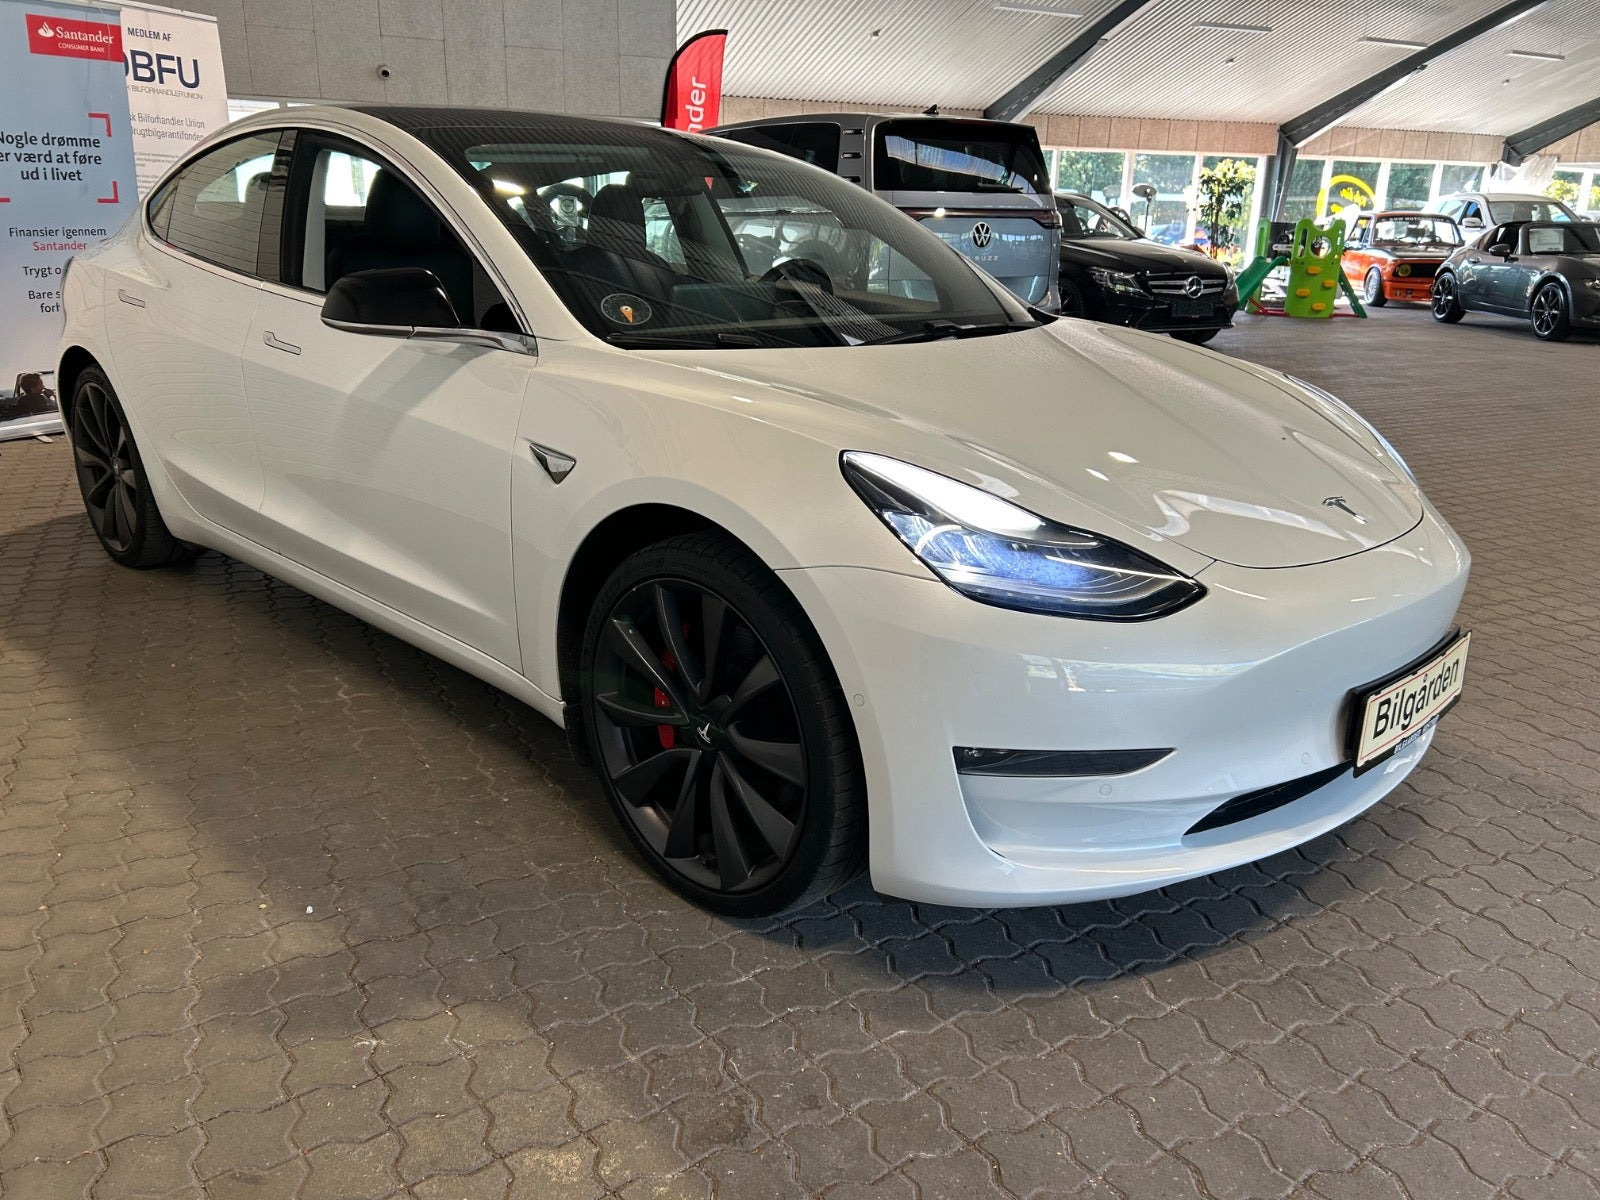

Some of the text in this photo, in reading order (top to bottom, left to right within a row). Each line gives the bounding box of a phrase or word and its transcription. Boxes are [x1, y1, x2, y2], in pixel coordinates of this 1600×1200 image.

[56, 26, 114, 44] Santander
[128, 27, 172, 41] MEDLEM AF
[58, 42, 105, 53] CONSUMER BANK
[138, 112, 184, 126] Bilforhandler
[186, 118, 205, 128] Union
[41, 132, 101, 148] drømme
[14, 150, 52, 164] værd
[56, 152, 71, 164] at
[72, 151, 102, 165] føre
[21, 167, 82, 181] ud i livet
[9, 228, 107, 239] Finansier igennem
[33, 241, 87, 251] Santander
[22, 266, 52, 278] Trygt
[28, 290, 53, 300] Bare
[1372, 658, 1460, 740] Bilgården
